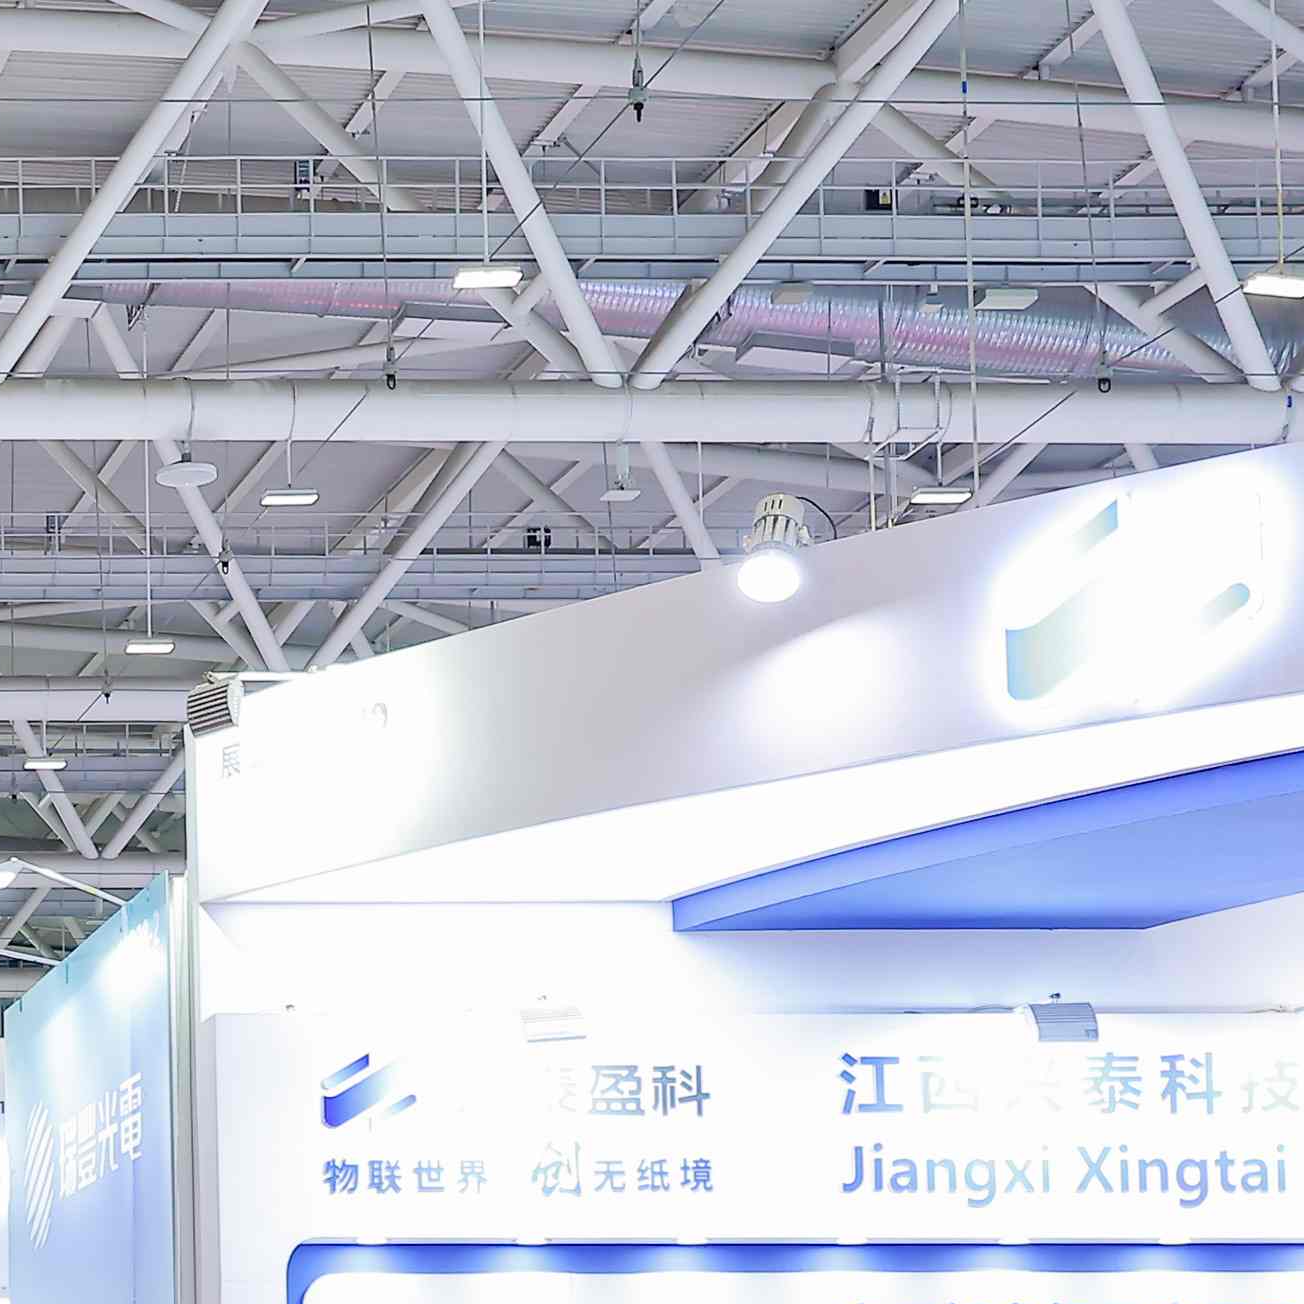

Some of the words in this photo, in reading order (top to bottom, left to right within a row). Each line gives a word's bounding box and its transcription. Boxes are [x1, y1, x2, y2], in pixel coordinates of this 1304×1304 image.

[544, 1064, 711, 1117] 盈科
[323, 1157, 488, 1195] 物联世界
[842, 1142, 1051, 1208] Jiangxi
[1076, 1142, 1288, 1208] Xingtai
